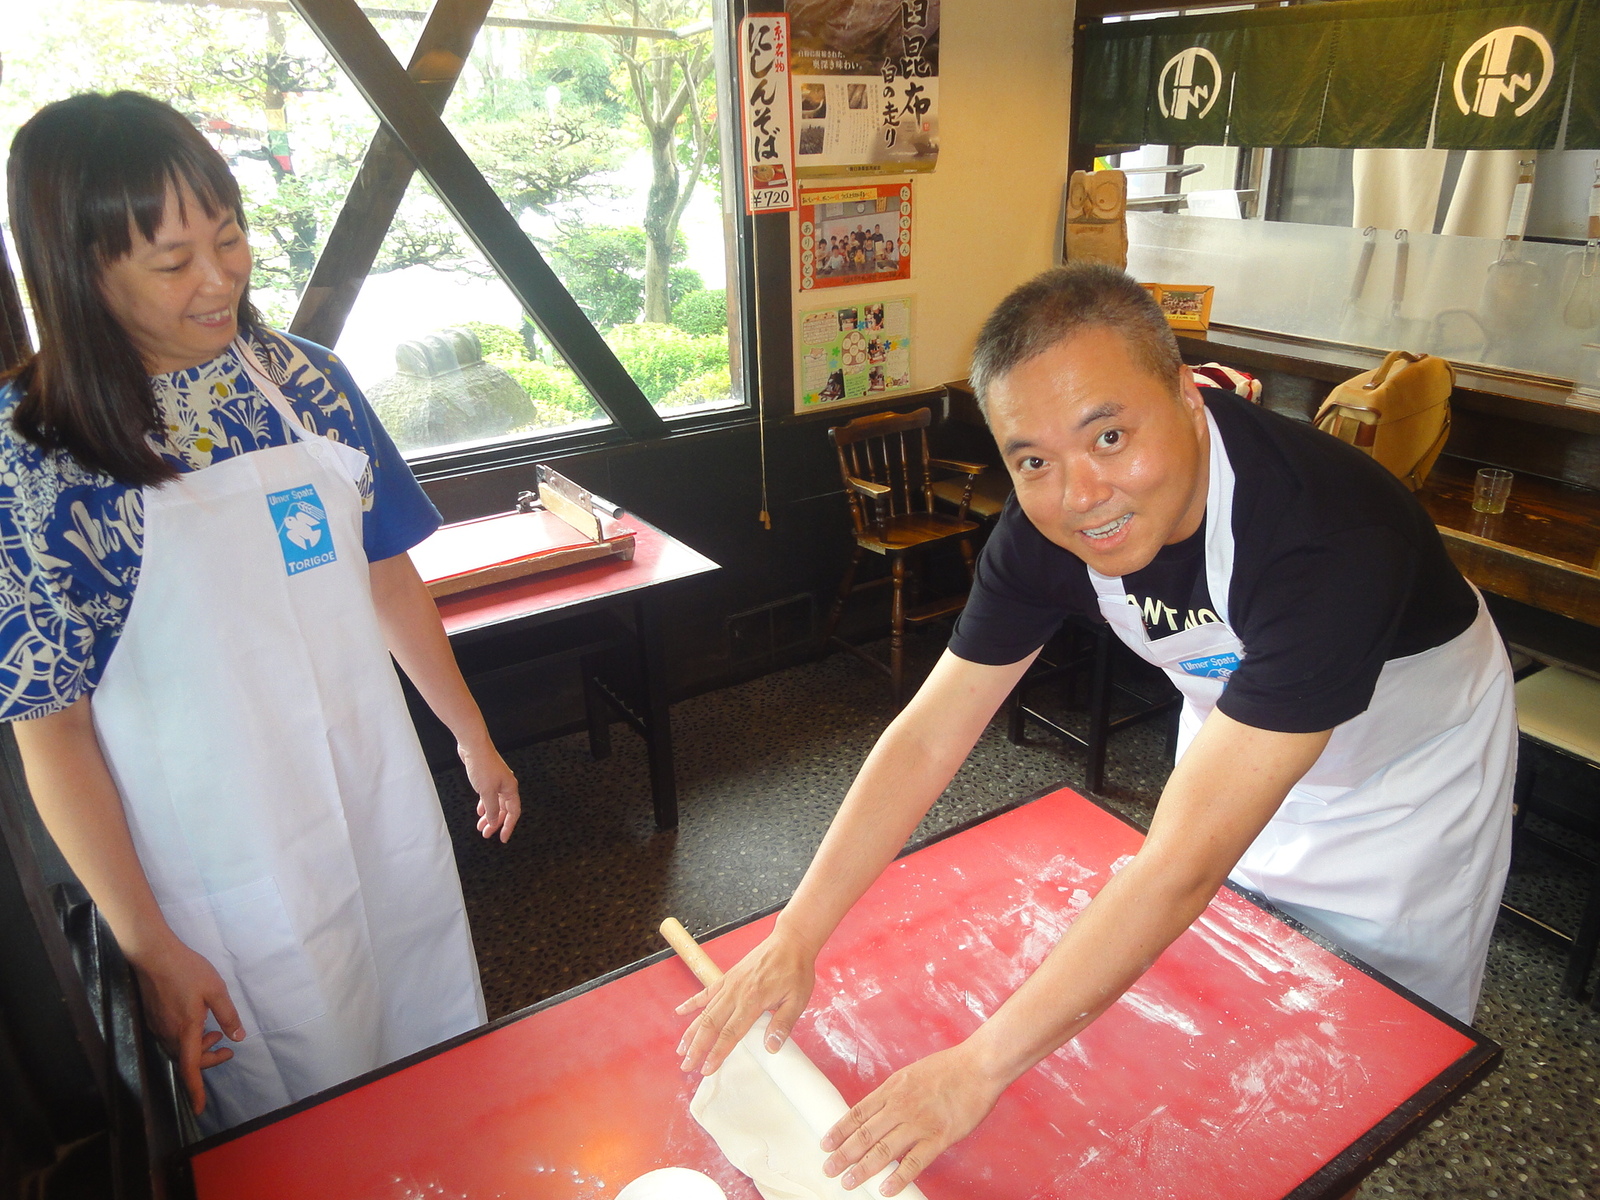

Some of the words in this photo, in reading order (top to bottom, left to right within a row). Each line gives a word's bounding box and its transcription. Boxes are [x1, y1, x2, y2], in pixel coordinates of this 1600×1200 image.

[773, 21, 785, 73] 京名物
[748, 23, 780, 162] にしんそば
[881, 57, 900, 148] 白の走り
[752, 190, 789, 207] ¥720
[803, 224, 813, 288] ありがとう
[269, 494, 290, 506] Ulmer
[291, 488, 314, 500] Spatz
[288, 551, 335, 573] TORIGOE
[1183, 660, 1209, 670] Ulmer
[1210, 656, 1237, 667] Spatz
